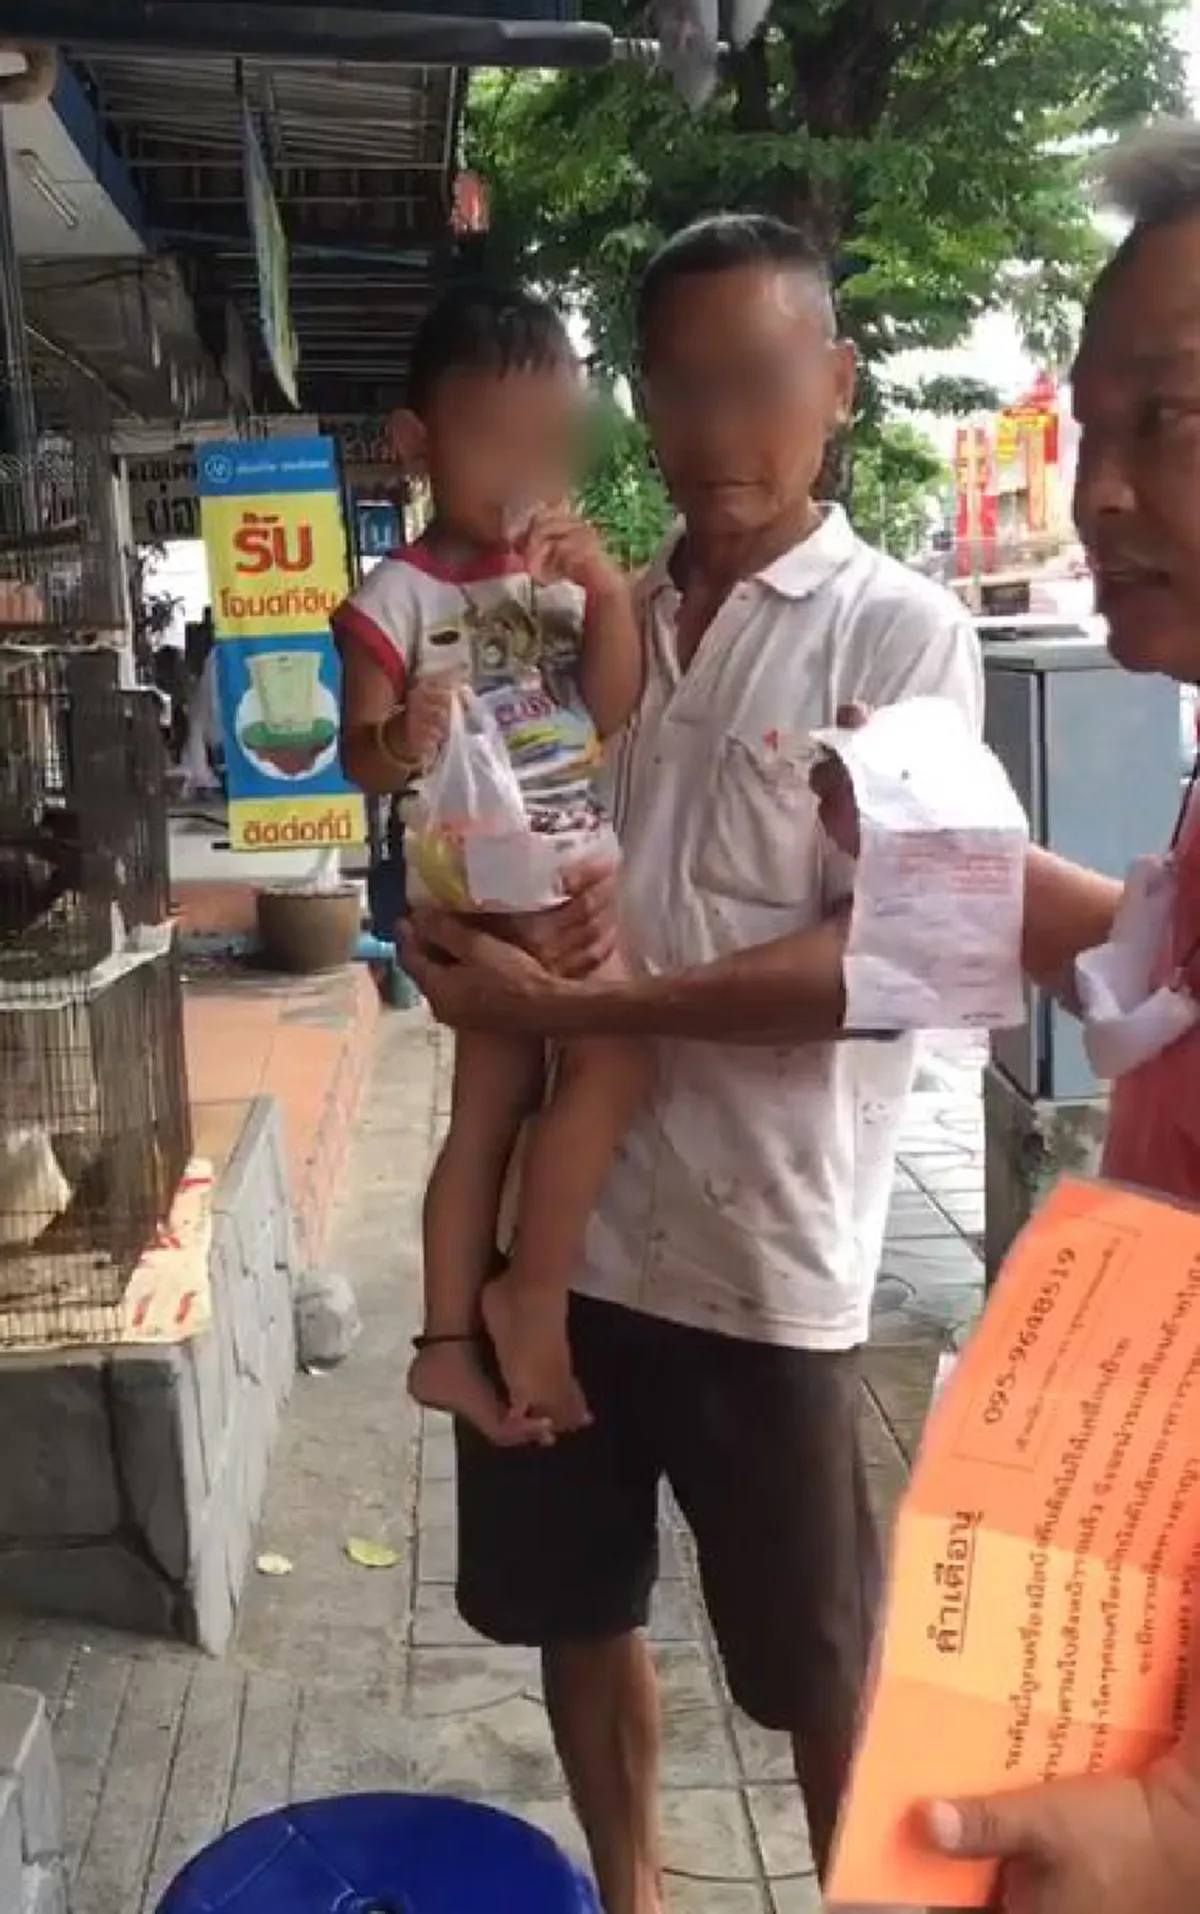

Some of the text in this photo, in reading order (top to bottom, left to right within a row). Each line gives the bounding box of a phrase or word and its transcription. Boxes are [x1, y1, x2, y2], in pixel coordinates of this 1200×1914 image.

[232, 512, 313, 573] รับ
[926, 1511, 976, 1654] คำเตือน
